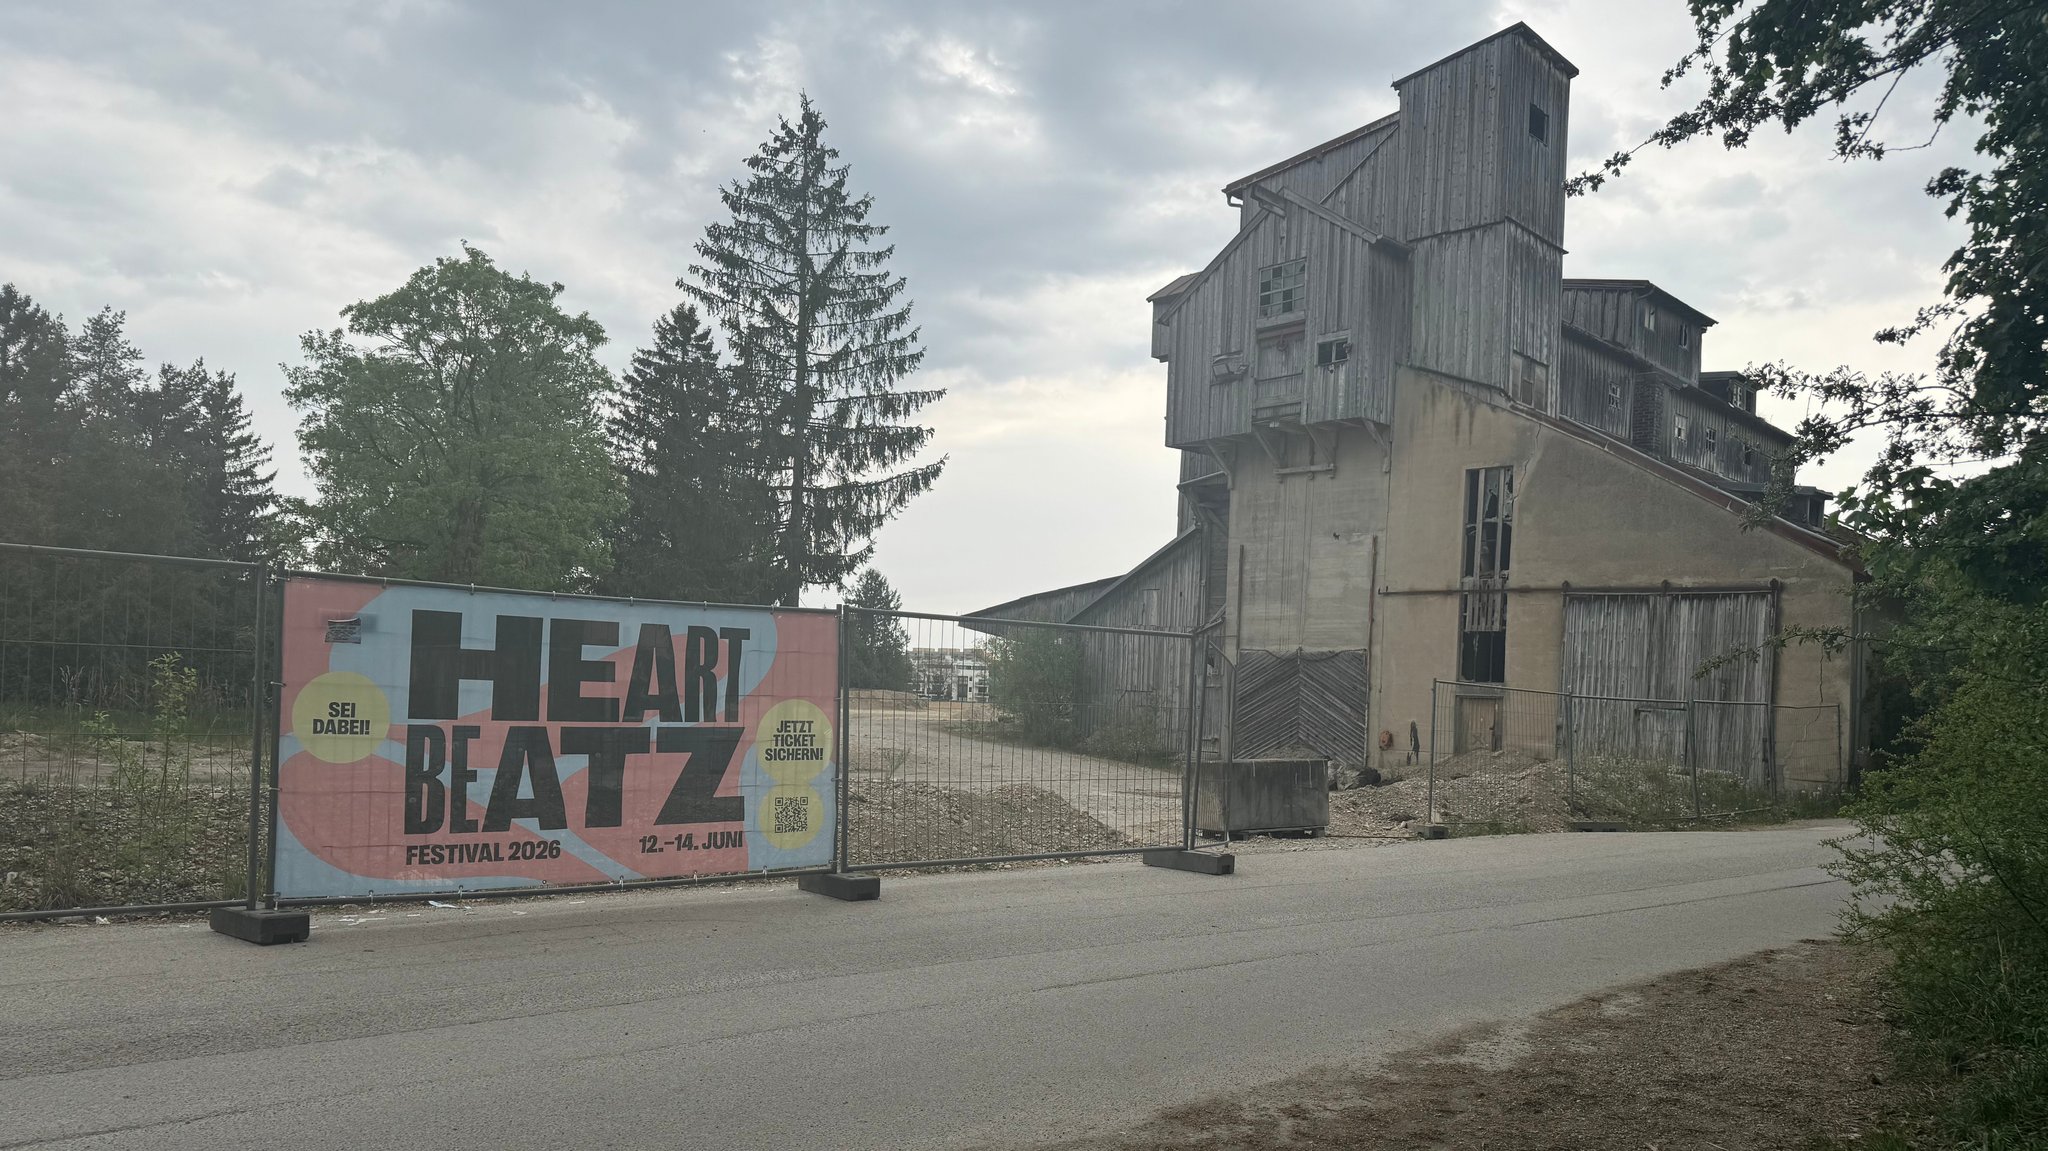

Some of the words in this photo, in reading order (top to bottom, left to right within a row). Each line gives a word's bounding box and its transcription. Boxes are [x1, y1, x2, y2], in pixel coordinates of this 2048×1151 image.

[407, 609, 751, 723] HEART
[328, 702, 356, 718] SEI
[312, 719, 370, 735] DABEI!
[776, 720, 814, 733] JETZT
[773, 734, 815, 747] TICKET
[765, 748, 824, 761] SICHERN!
[403, 724, 745, 835] BEATZ
[702, 831, 743, 849] JUNI
[406, 843, 504, 865] FESTIVAL
[508, 840, 561, 861] 2026
